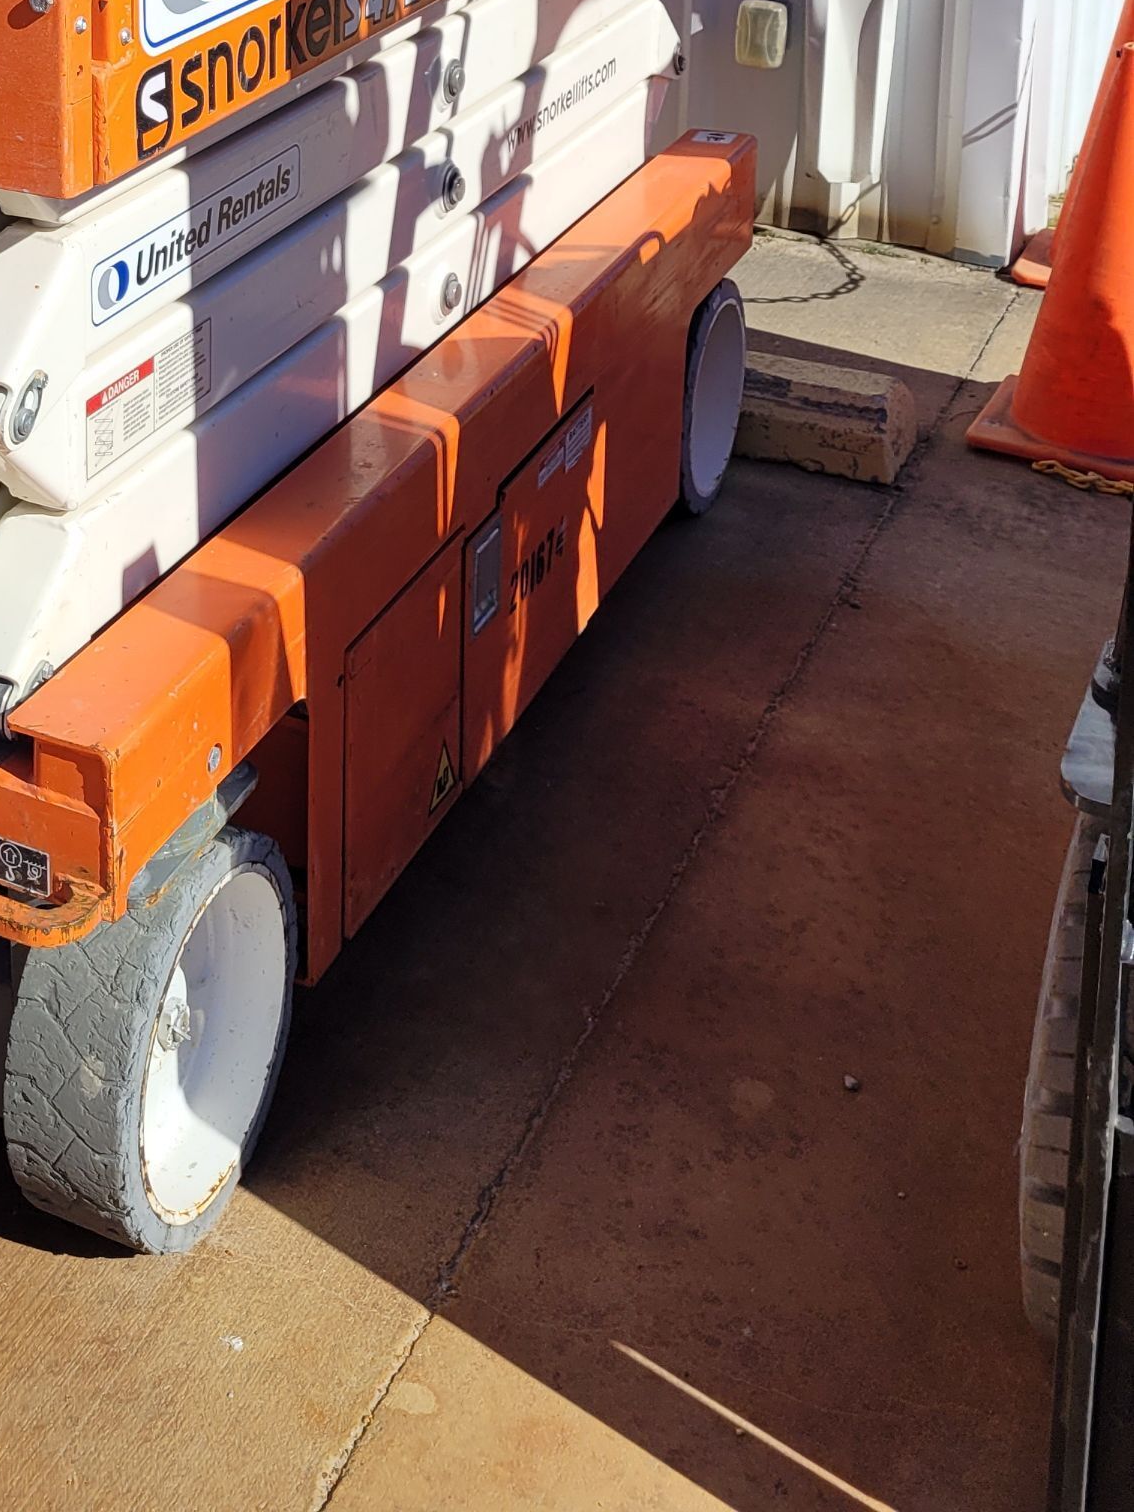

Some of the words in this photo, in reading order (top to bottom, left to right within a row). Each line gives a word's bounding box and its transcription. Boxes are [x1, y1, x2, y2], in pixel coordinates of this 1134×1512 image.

[136, 208, 212, 286] United
[217, 164, 291, 236] Rentals
[108, 369, 139, 399] DANGER
[509, 516, 566, 614] 201674
